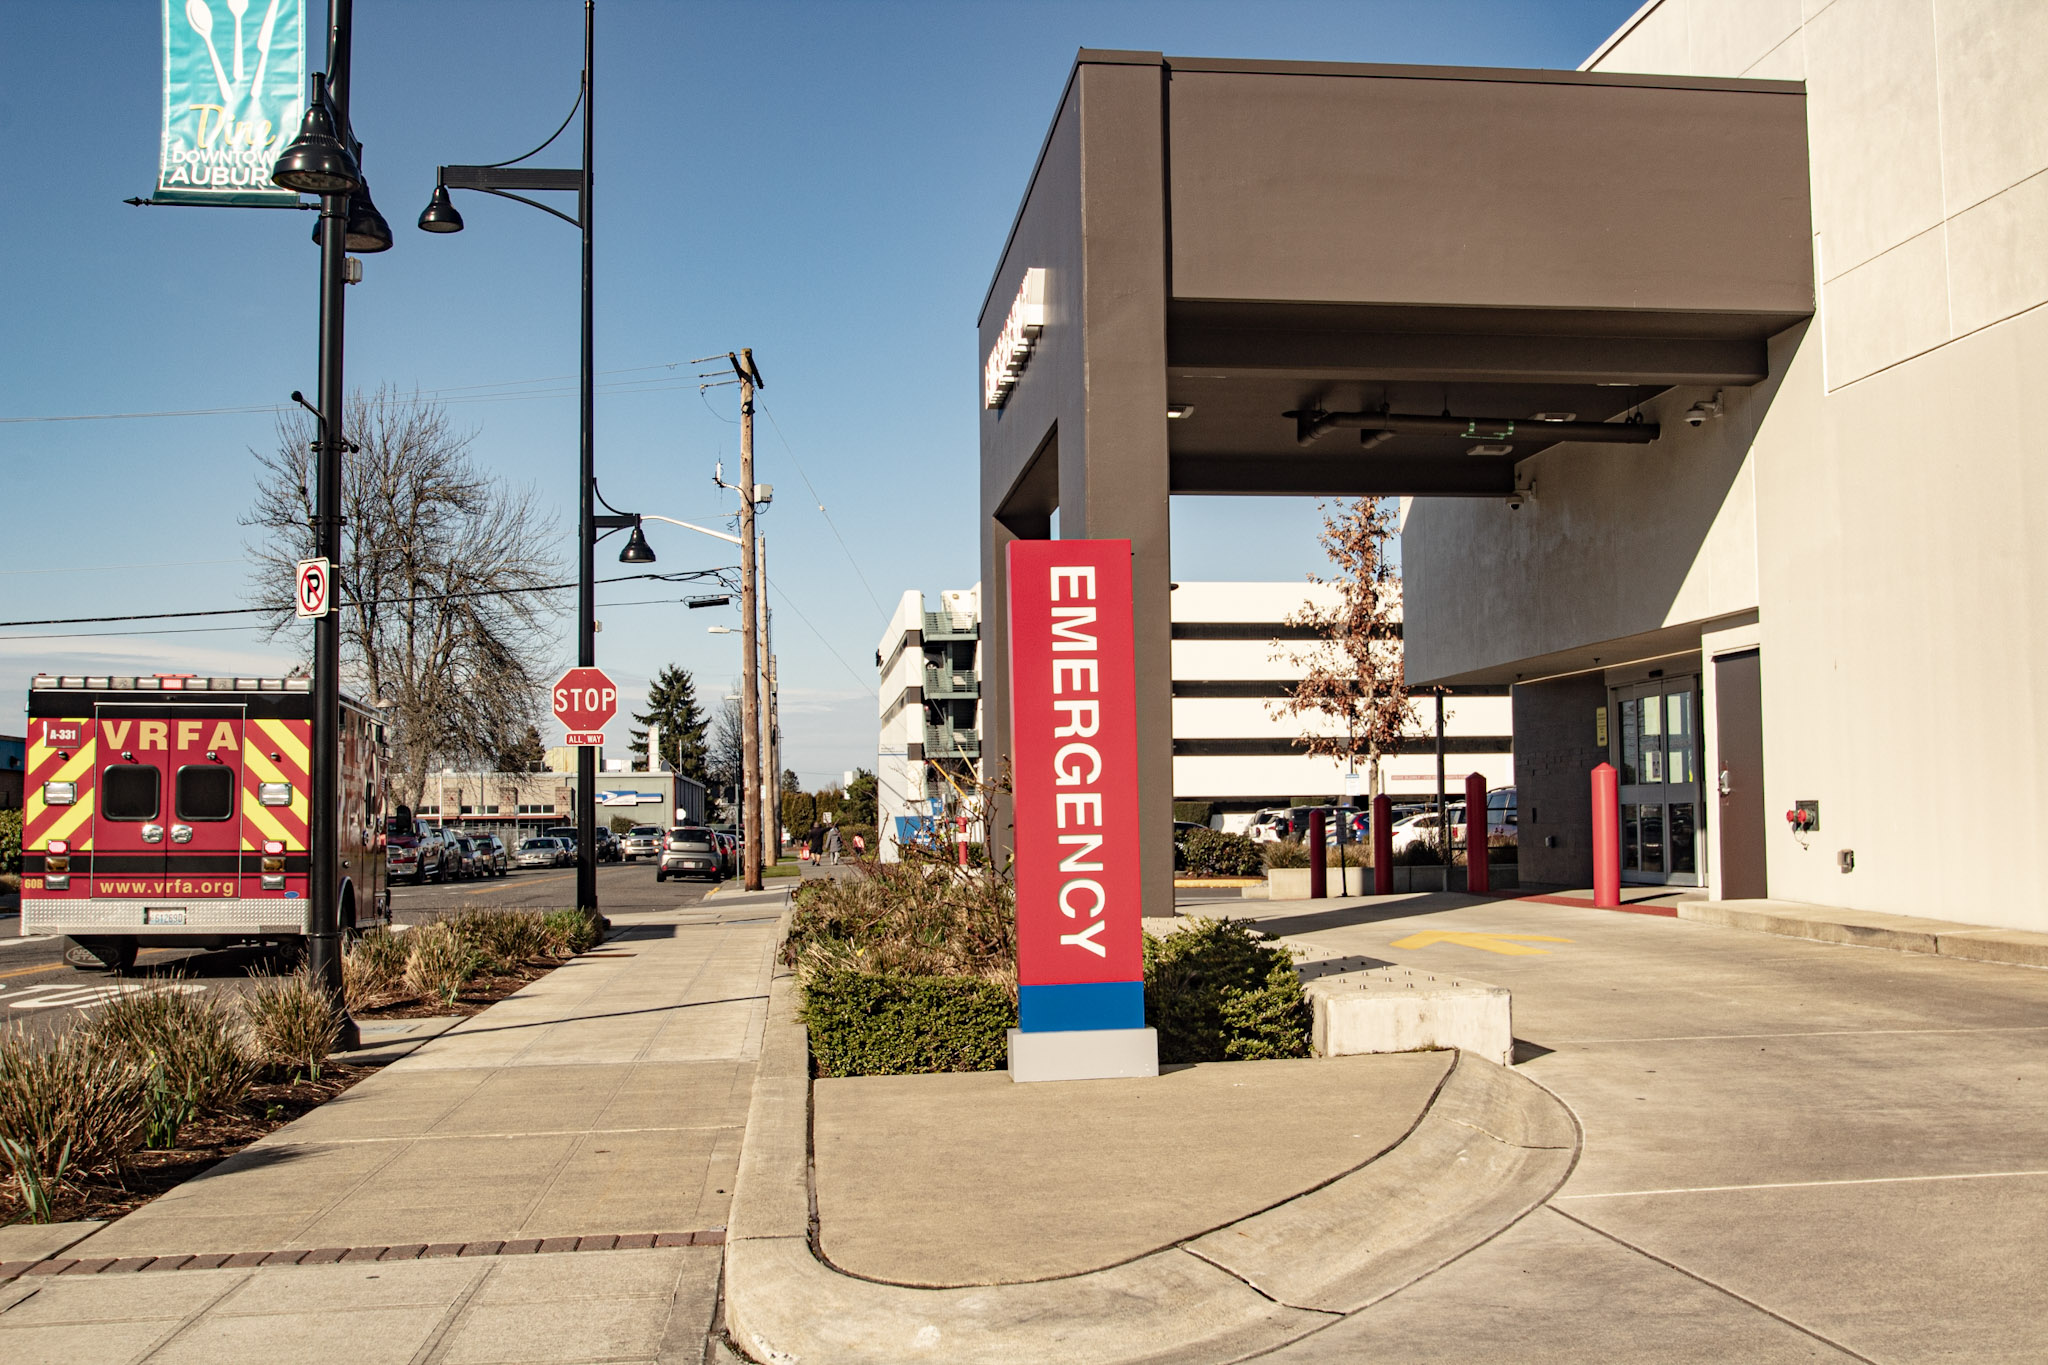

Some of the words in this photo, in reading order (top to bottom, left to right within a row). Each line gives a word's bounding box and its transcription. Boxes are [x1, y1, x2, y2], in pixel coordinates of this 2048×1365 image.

[189, 104, 276, 149] Dine
[168, 166, 277, 186] AUBUR
[555, 688, 615, 712] STOP
[50, 729, 76, 740] A-331
[101, 720, 239, 751] VRFA
[568, 735, 582, 743] ALL
[587, 735, 601, 743] WAY
[1050, 566, 1106, 958] EMERGENCY
[100, 879, 233, 897] www.vrfa.org
